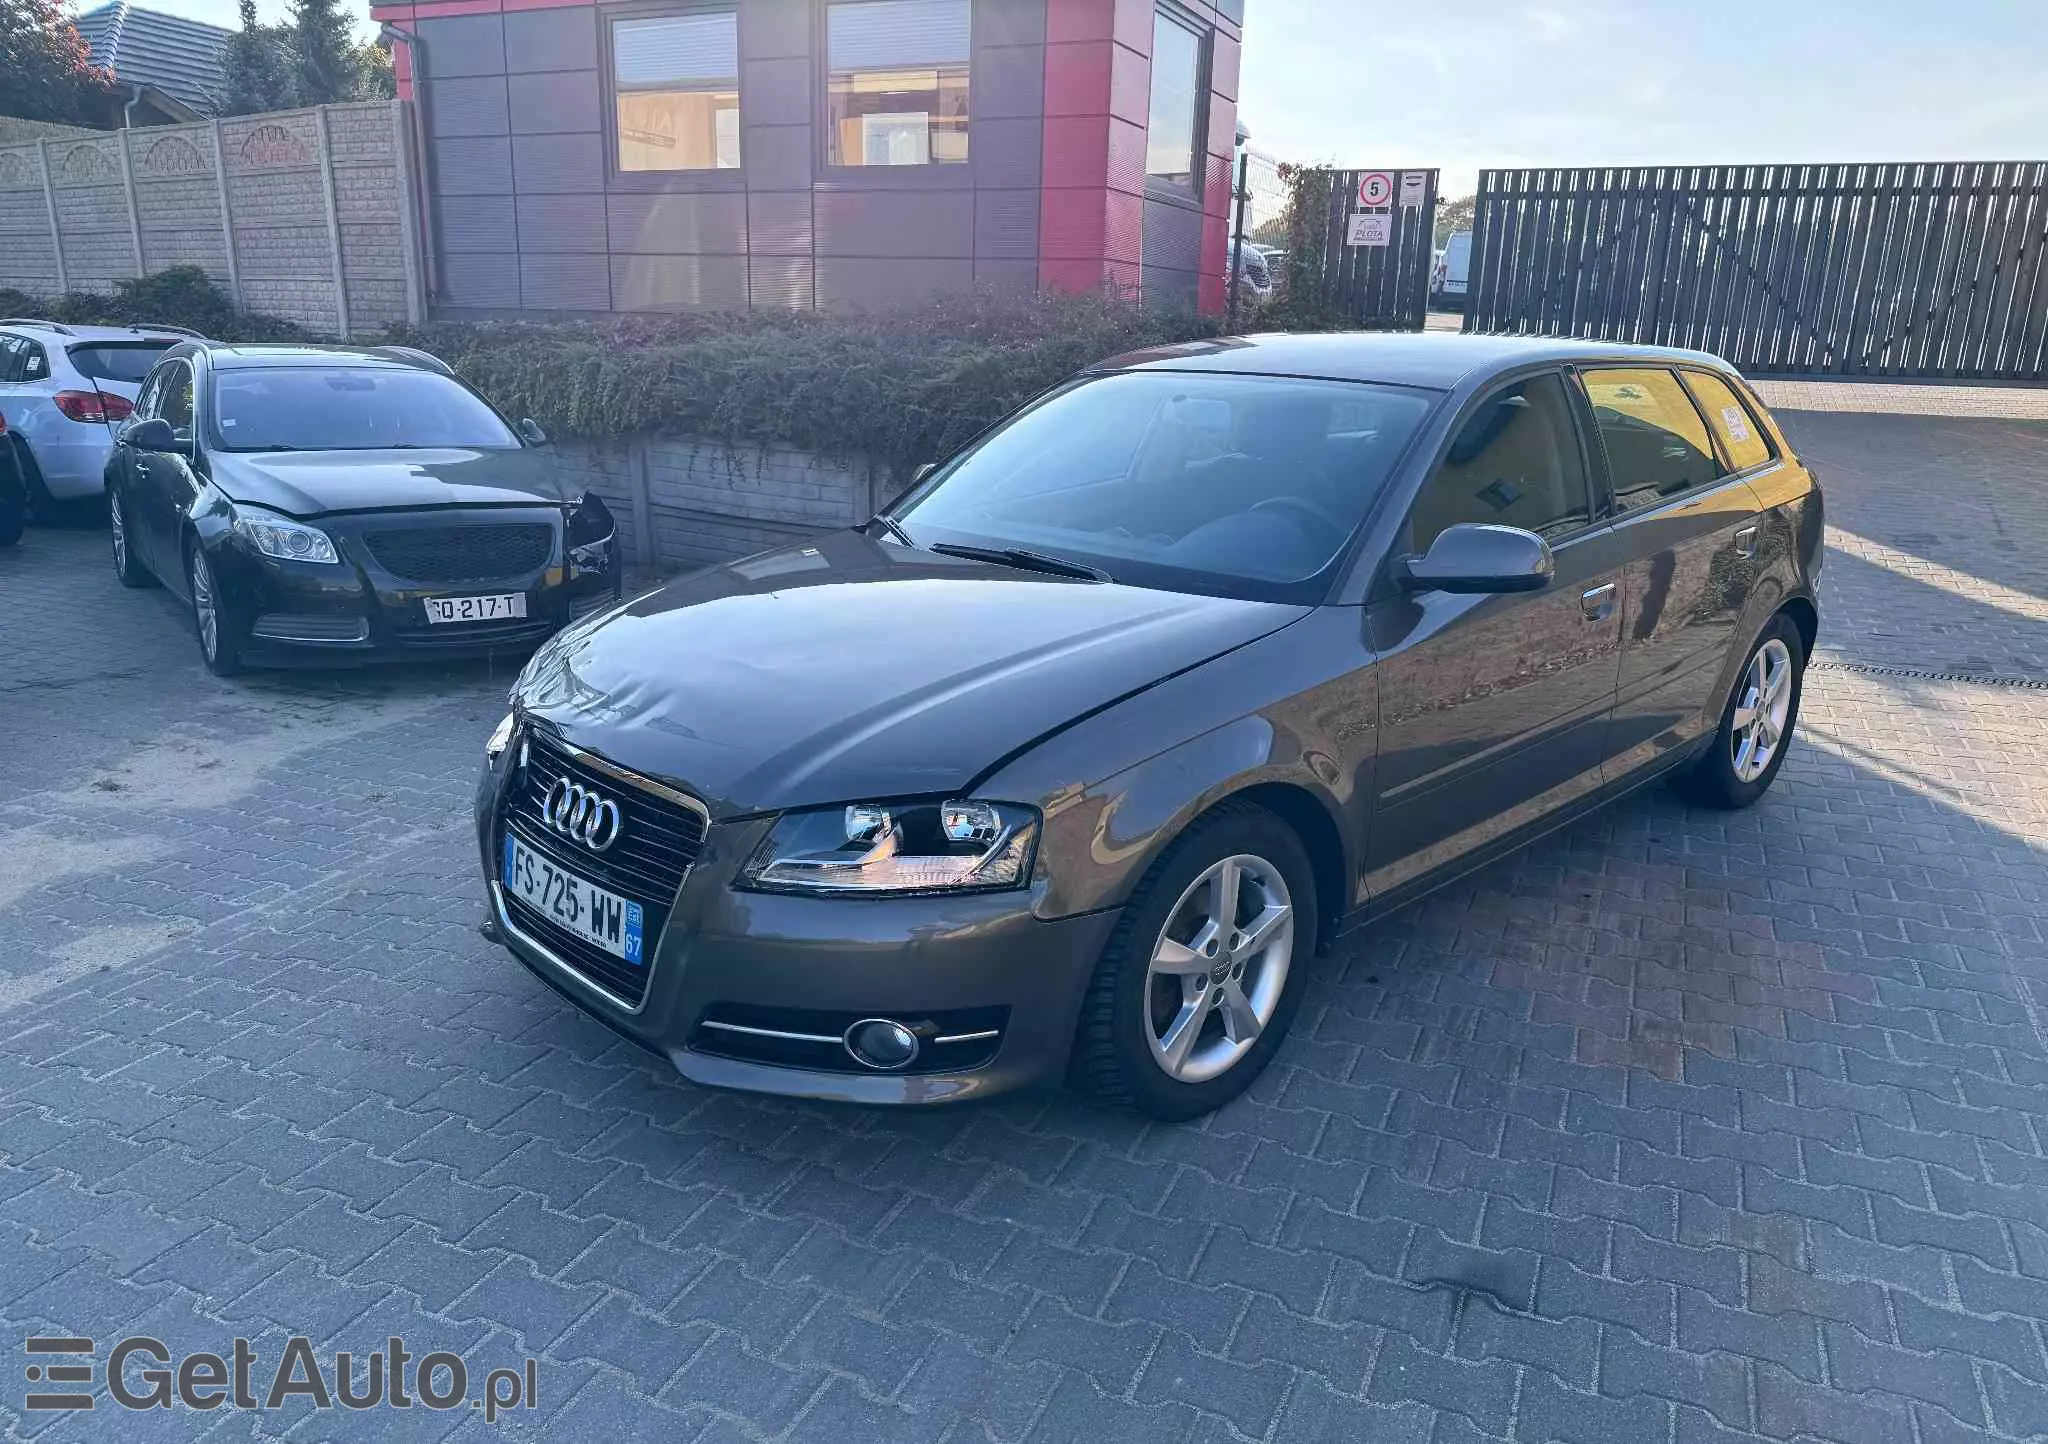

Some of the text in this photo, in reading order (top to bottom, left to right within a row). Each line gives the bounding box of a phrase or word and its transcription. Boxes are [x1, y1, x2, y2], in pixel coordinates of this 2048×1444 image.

[1370, 182, 1380, 196] 5
[514, 848, 622, 944] FS-725-WW
[625, 932, 642, 957] 67
